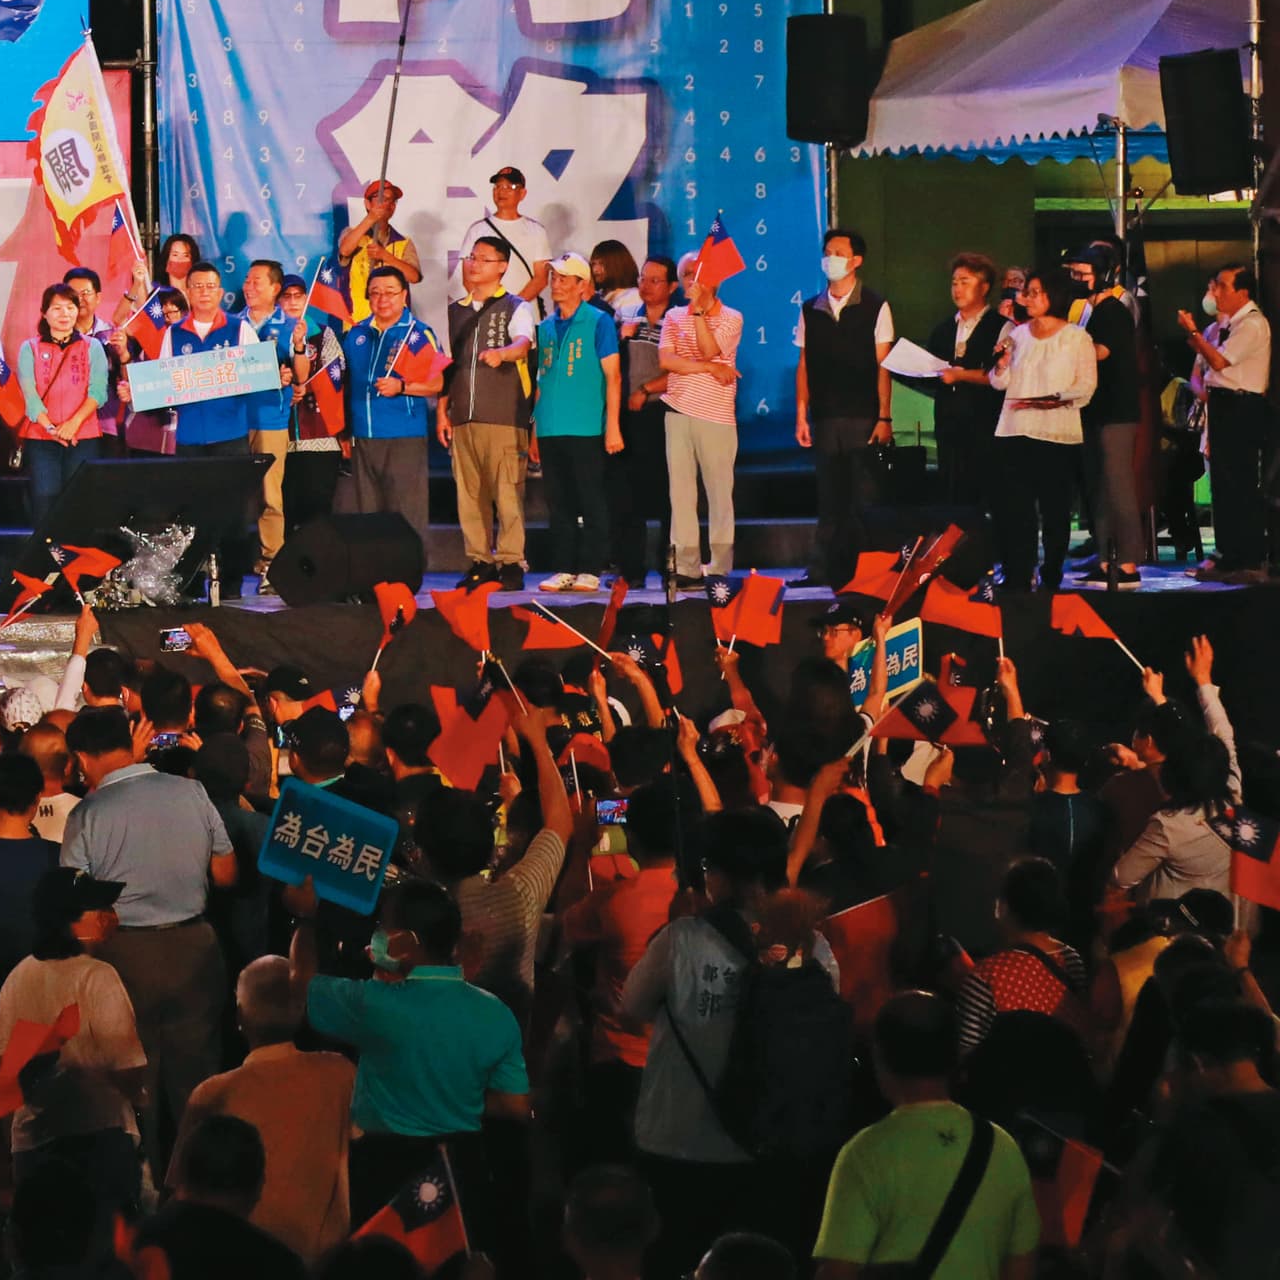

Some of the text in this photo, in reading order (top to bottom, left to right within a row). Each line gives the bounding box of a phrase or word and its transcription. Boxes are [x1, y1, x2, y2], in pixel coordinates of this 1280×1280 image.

[685, 2, 762, 18] 1 9 5
[720, 39, 763, 53] 2 8
[684, 74, 764, 91] 2 7
[684, 109, 730, 125] 4 9
[685, 147, 800, 163] 6 4 6 3
[652, 182, 766, 200] 7 5 8
[687, 218, 767, 235] 1 6
[223, 255, 307, 273] 5 9
[756, 255, 767, 271] 6
[223, 291, 236, 309] 9
[790, 289, 803, 307] 4
[757, 326, 766, 344] 1
[172, 362, 239, 393] 郭台銘
[756, 397, 769, 416] 6
[849, 642, 919, 694] 為為民
[273, 810, 384, 884] 為台為民
